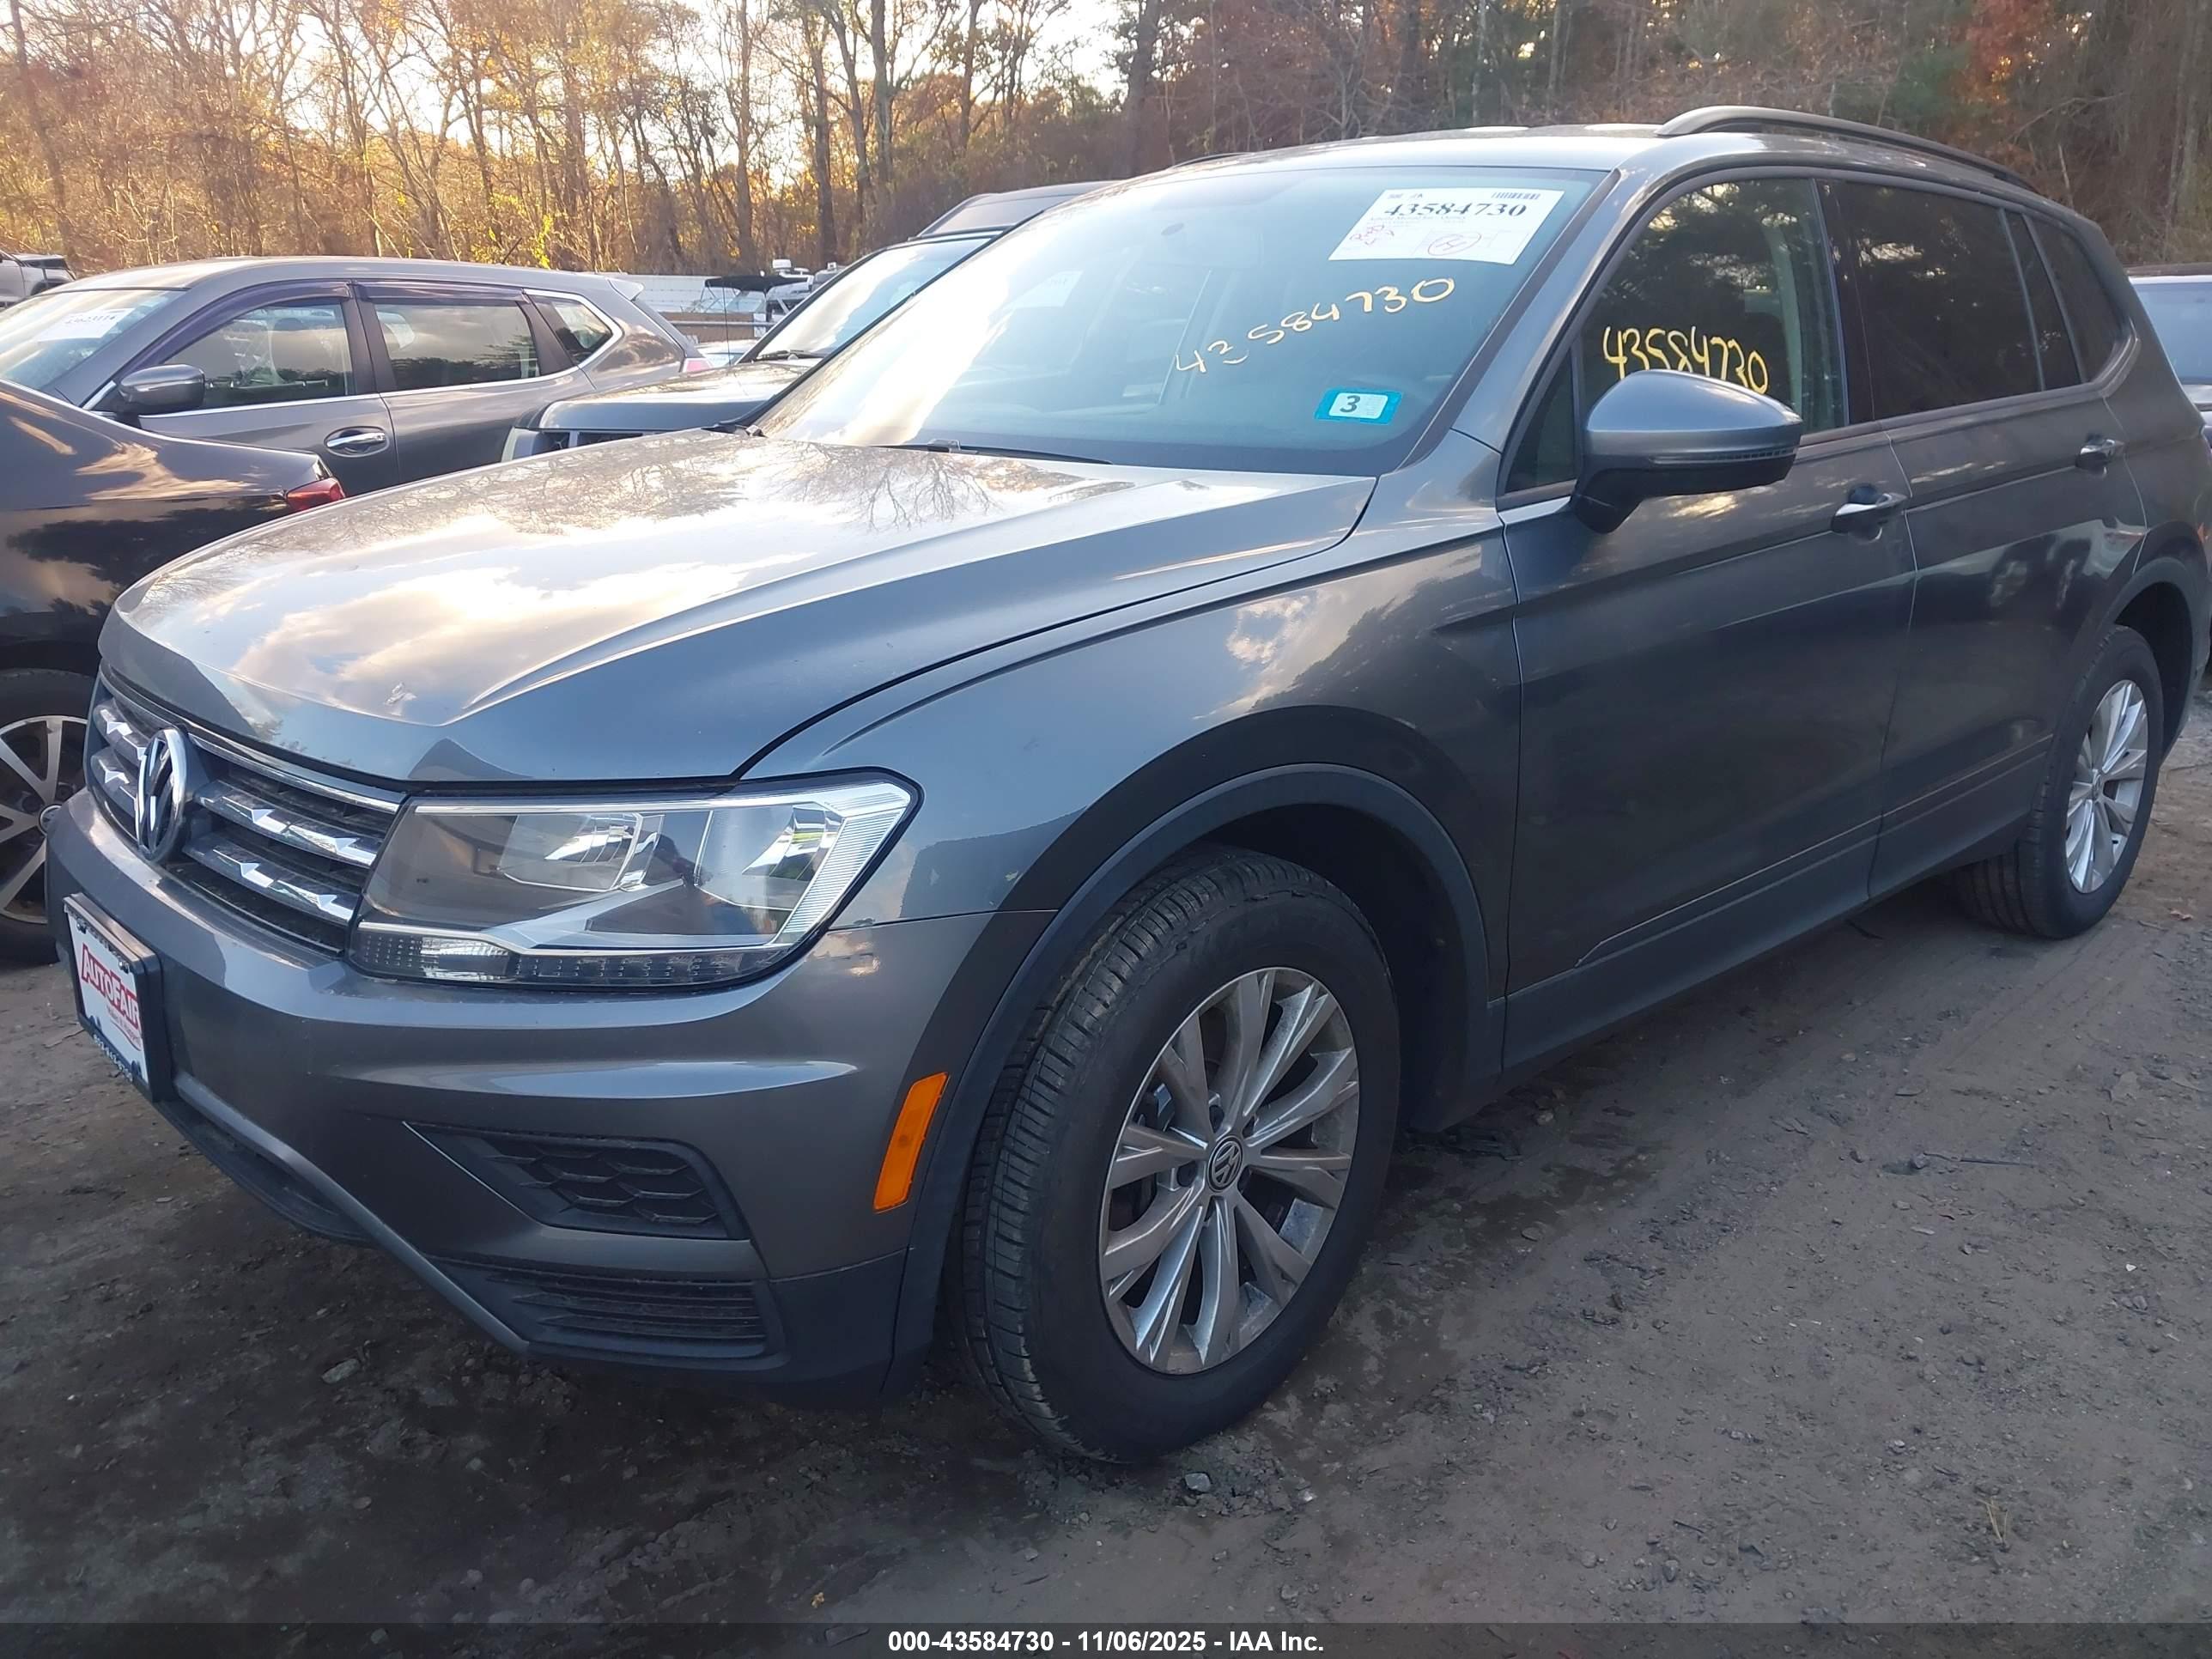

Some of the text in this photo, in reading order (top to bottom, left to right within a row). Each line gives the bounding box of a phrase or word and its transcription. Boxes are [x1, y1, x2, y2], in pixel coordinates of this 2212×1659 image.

[1383, 202, 1527, 217] 43584730
[1175, 277, 1455, 374] 43584730
[1602, 325, 1769, 395] 43584730
[1340, 394, 1362, 413] 3
